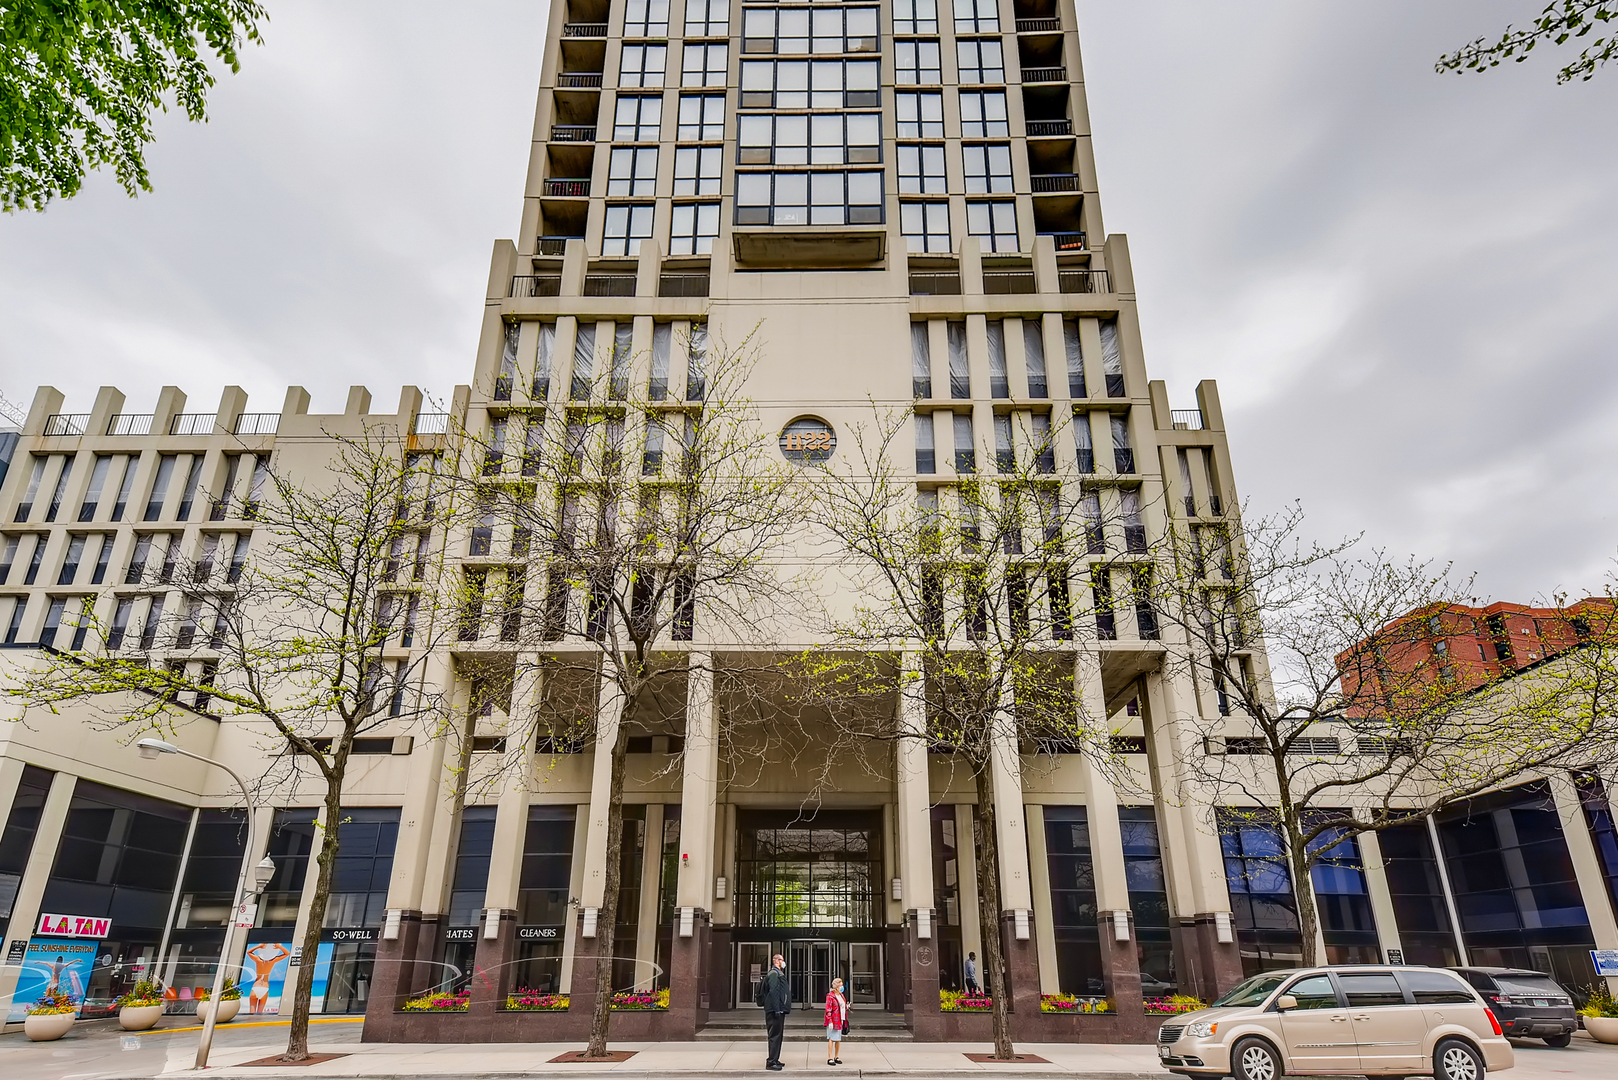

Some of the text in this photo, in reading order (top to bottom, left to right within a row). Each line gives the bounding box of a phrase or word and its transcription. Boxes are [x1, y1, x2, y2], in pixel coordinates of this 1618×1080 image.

[785, 431, 831, 452] 1122
[41, 915, 108, 936] L.A. TAN
[520, 928, 557, 938] CLEANERS
[28, 943, 97, 954] FEEL SUNSHINE EVERYDAY
